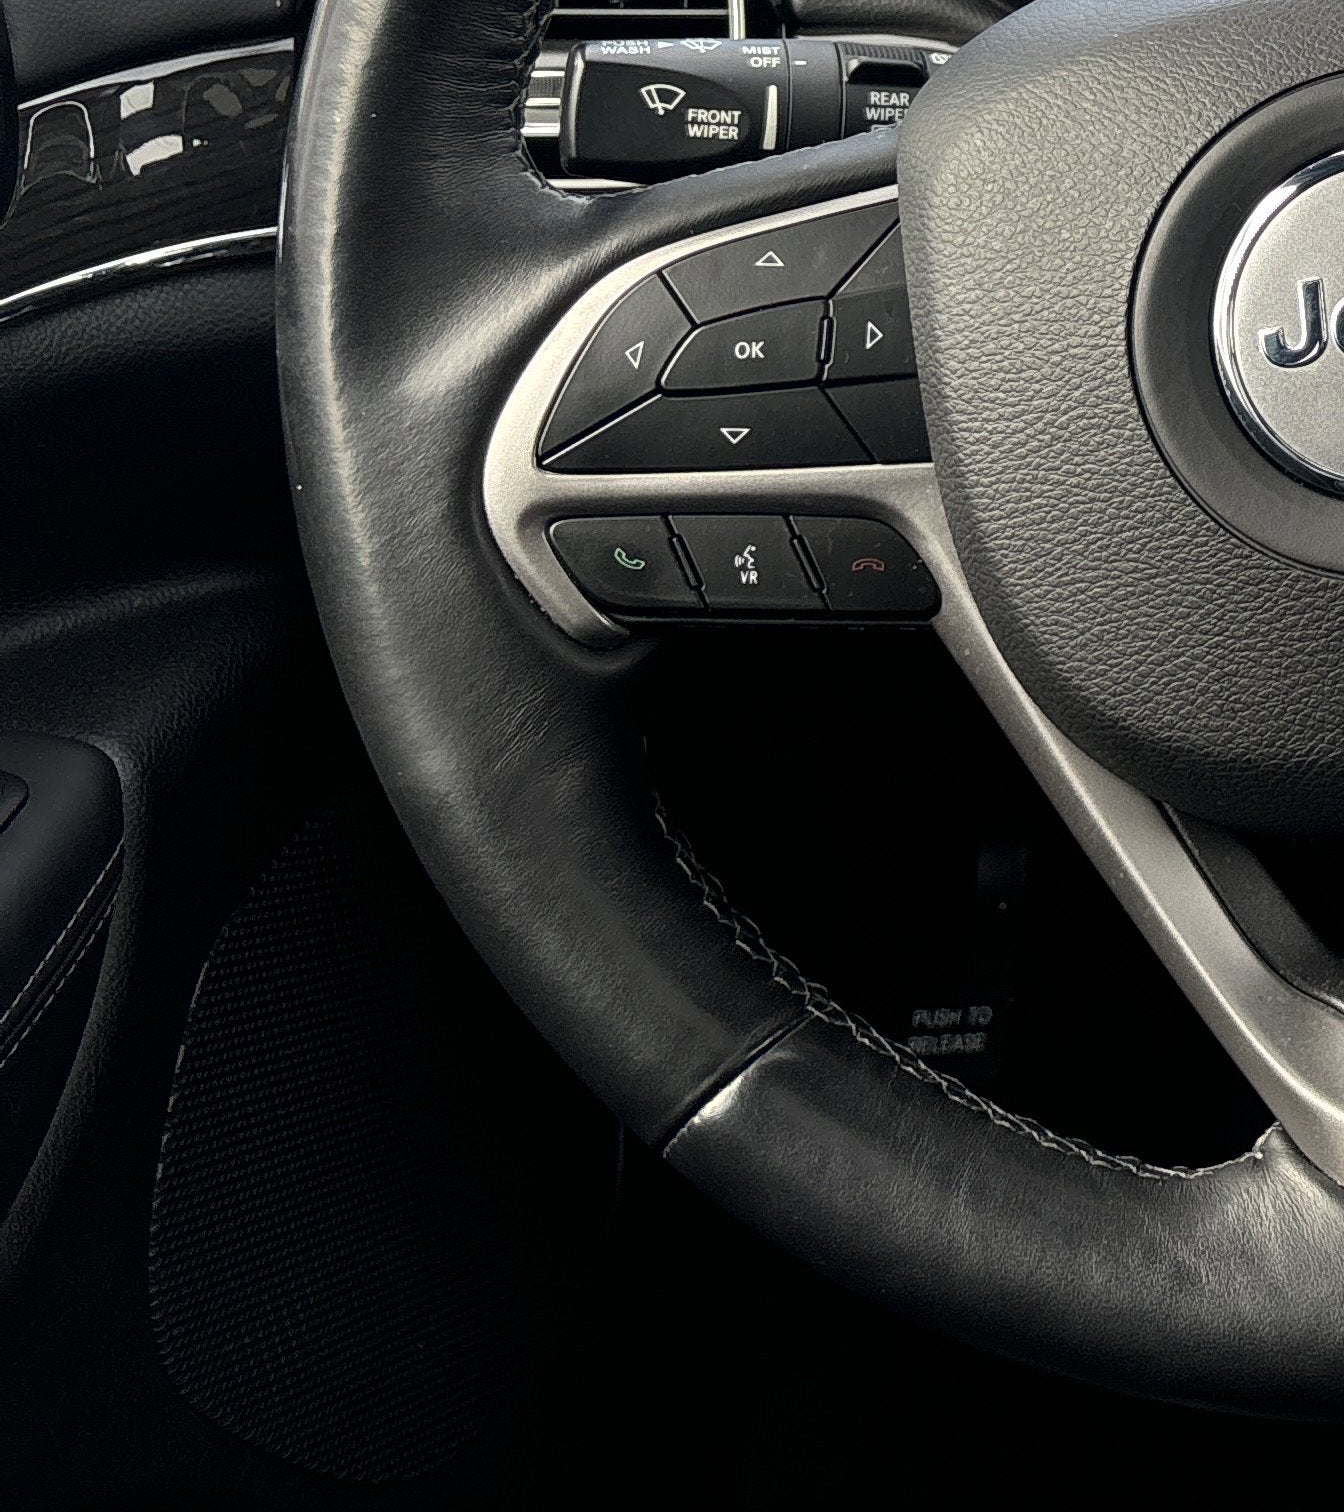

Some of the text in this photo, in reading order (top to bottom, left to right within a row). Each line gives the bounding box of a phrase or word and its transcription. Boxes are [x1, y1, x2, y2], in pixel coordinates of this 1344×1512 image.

[600, 46, 651, 55] WASH
[742, 46, 780, 55] MIST
[750, 57, 780, 68] OFF
[870, 91, 910, 106] REAR
[688, 109, 741, 124] FRONT
[688, 124, 739, 140] WIPER
[734, 341, 765, 359] OK
[740, 571, 758, 584] VR
